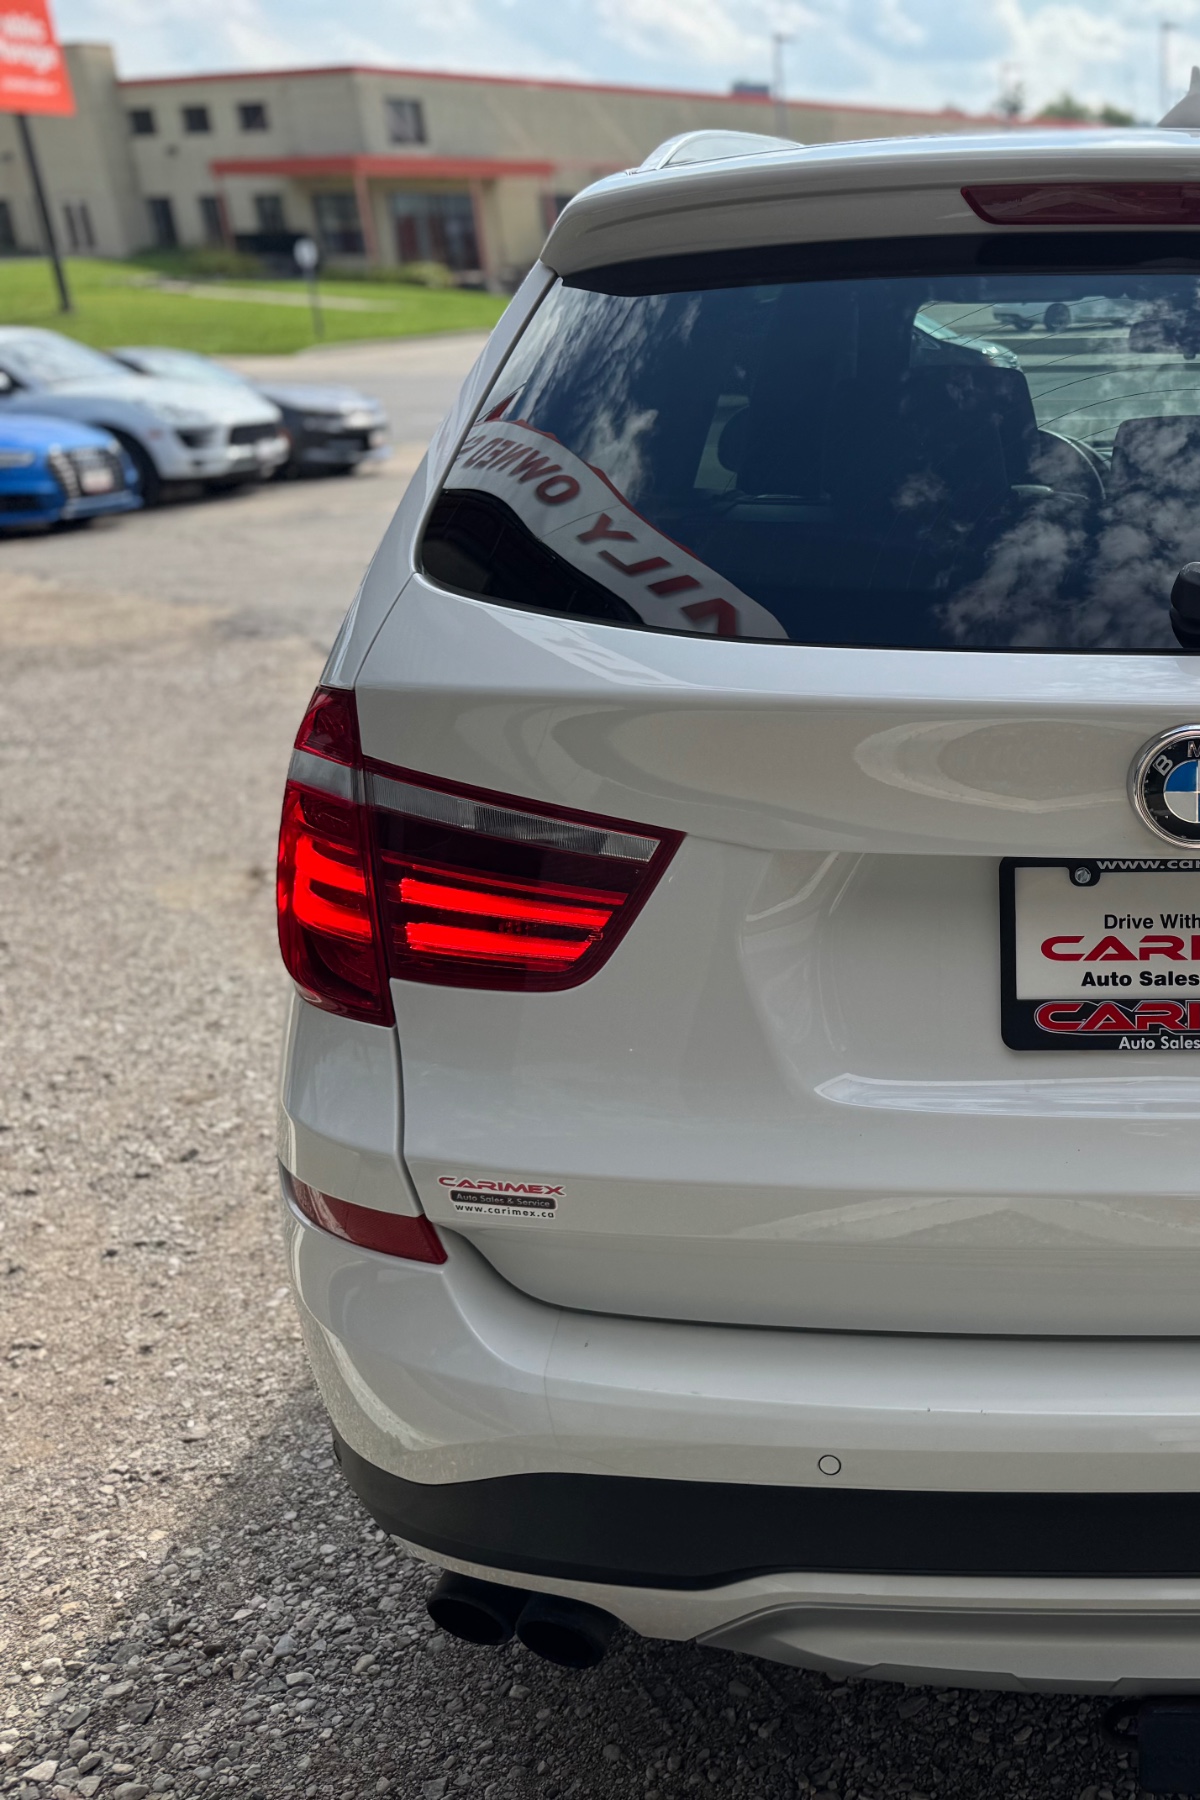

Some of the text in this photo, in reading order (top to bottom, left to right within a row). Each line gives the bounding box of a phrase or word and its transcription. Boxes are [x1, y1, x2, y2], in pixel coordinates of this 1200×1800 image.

[1104, 914, 1154, 930] Drive
[1081, 971, 1132, 987] Auto
[1139, 971, 1200, 986] Sales
[1118, 1036, 1156, 1050] Auto
[1160, 1035, 1200, 1049] Sales
[438, 1177, 566, 1196] CARIMEX
[456, 1193, 478, 1202] Auto
[480, 1195, 504, 1204] Sales
[517, 1198, 550, 1208] Service
[455, 1204, 555, 1218] www.carimex.ca
